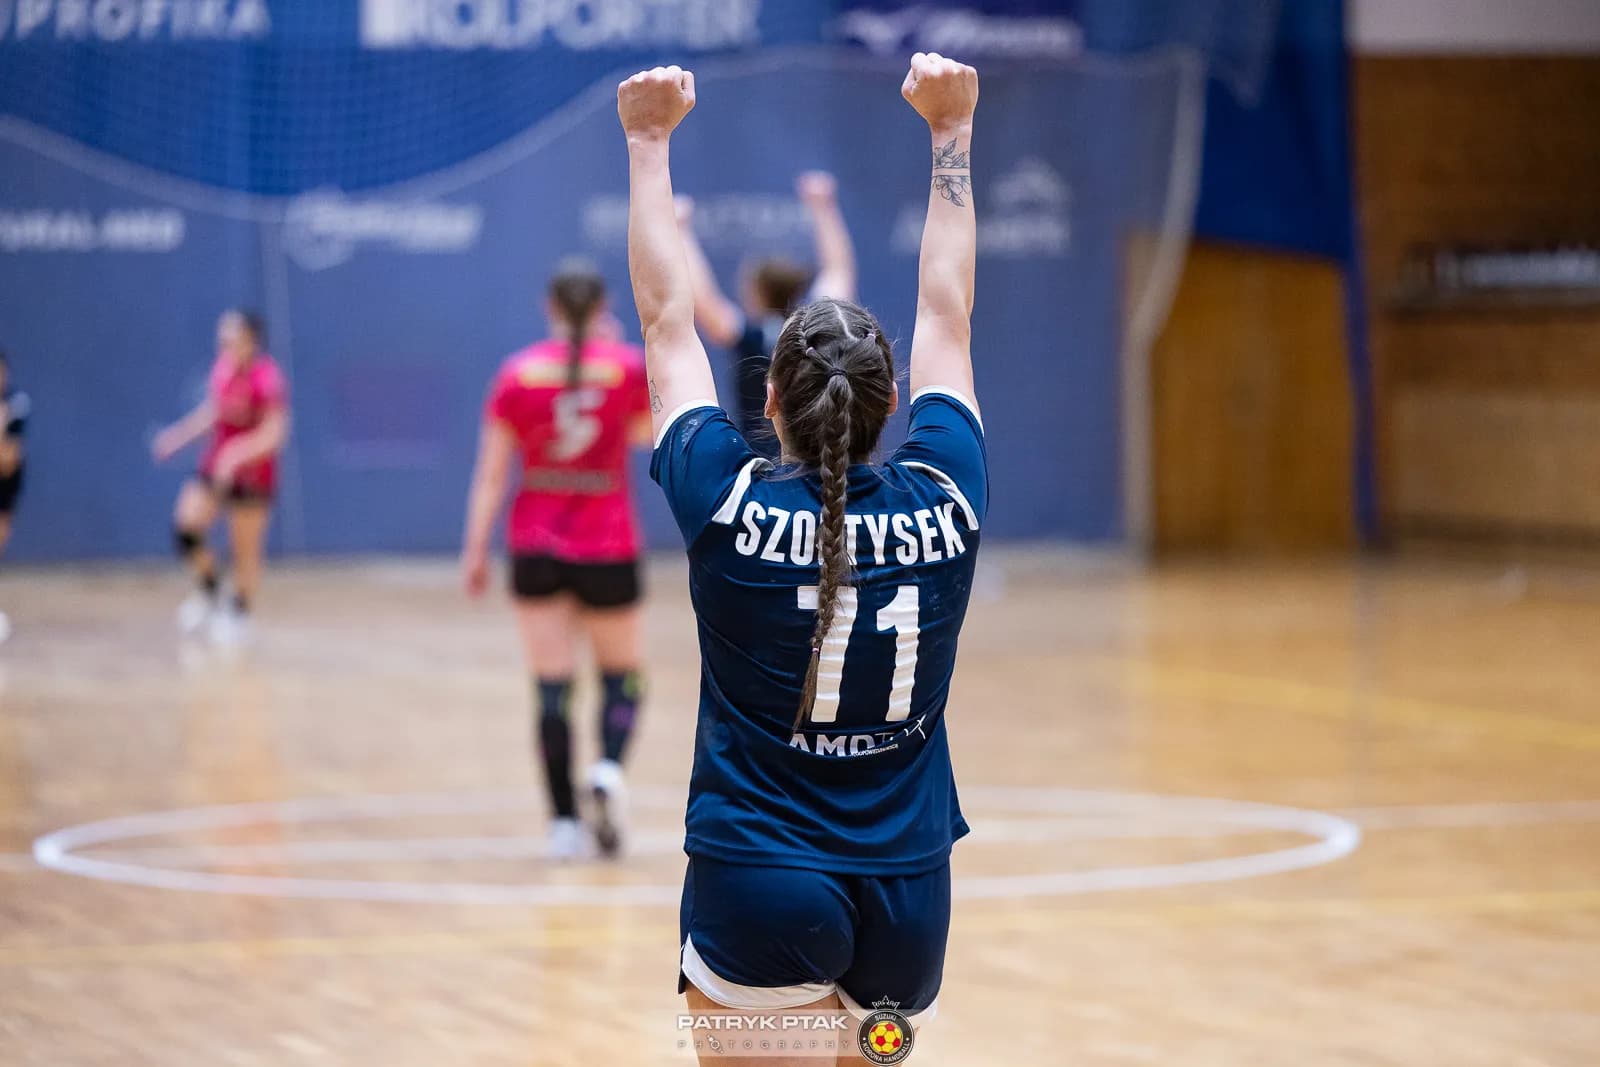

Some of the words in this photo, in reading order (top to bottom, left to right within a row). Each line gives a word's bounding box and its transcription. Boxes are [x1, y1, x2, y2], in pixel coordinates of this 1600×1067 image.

[548, 387, 606, 460] 5
[735, 501, 966, 566] SZOTYSEK
[797, 585, 920, 722] 71
